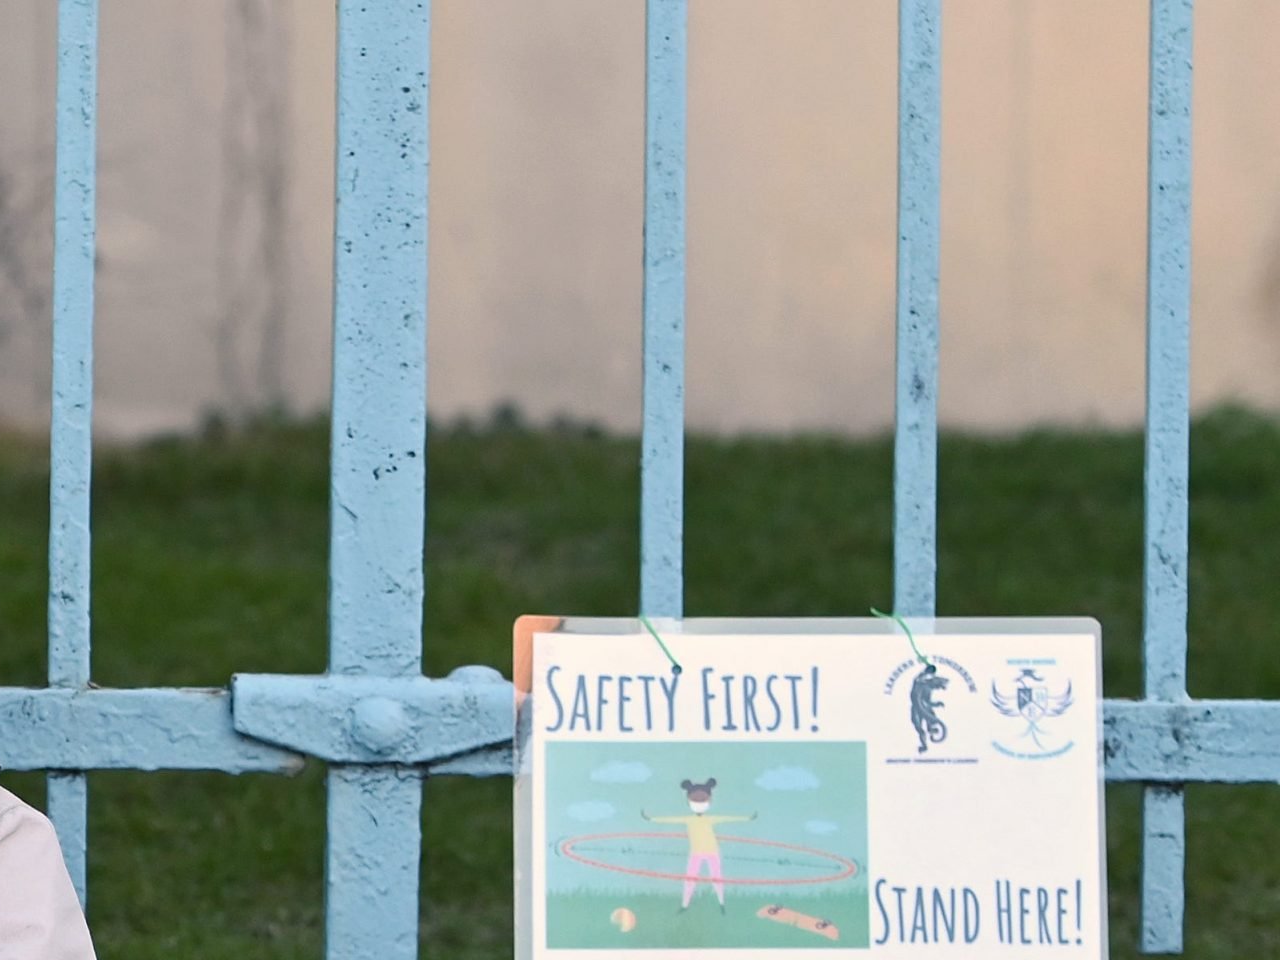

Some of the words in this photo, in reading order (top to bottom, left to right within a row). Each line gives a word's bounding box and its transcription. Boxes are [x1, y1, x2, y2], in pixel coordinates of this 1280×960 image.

[545, 665, 682, 732] SAFETY
[701, 666, 819, 732] FIRST!
[874, 878, 981, 945] STAND
[995, 879, 1083, 946] HERE!
